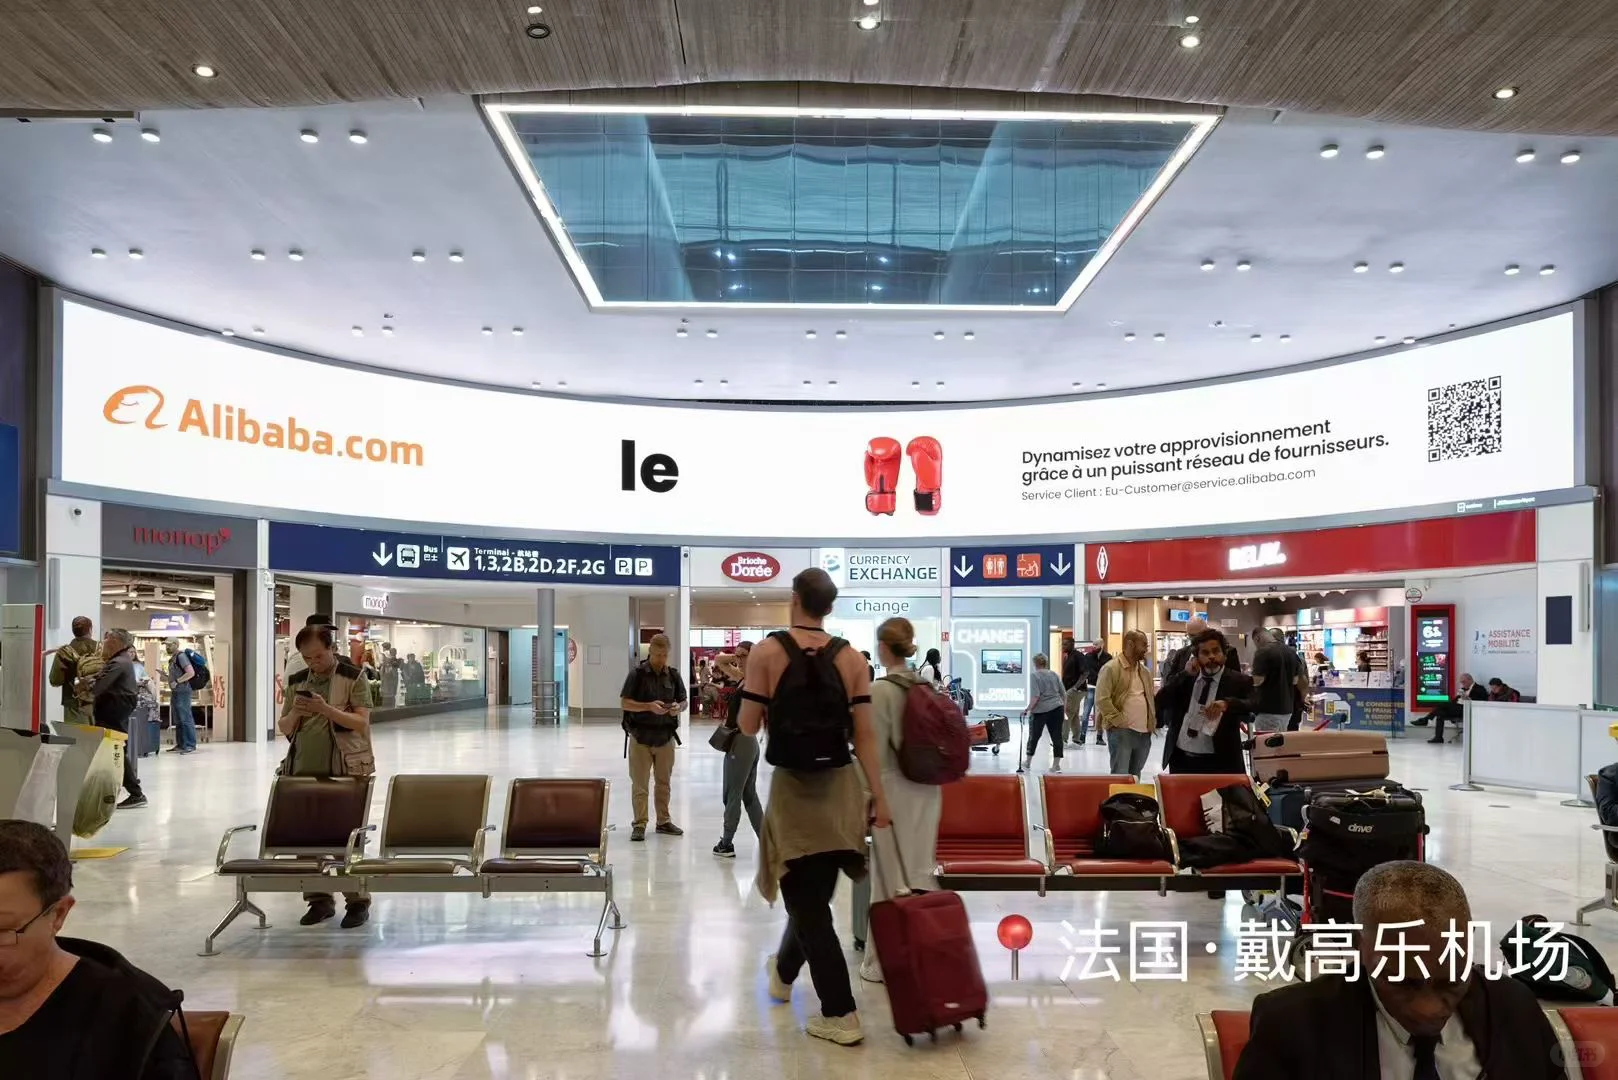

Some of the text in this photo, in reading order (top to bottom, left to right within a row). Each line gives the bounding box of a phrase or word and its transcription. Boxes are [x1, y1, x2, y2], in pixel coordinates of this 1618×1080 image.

[178, 398, 424, 467] Alibaba.com
[1022, 419, 1332, 468] Dynamisez votre approvisionnement
[621, 439, 679, 493] le
[1022, 433, 1390, 487] grâce à un puissant réseau de fournisseurs.
[1021, 490, 1062, 501] Service
[1064, 487, 1098, 499] Client
[1105, 468, 1317, 497] Eu-Customer@service.alibaba.com
[423, 544, 438, 554] Bus
[474, 546, 510, 557] Terminal
[423, 553, 438, 562] 巴士
[474, 555, 606, 576] 1,3,2B,2D,2F,2G
[737, 556, 768, 566] Brioche
[849, 555, 911, 565] CURRENCY
[731, 561, 773, 578] Dorée
[849, 567, 938, 580] EXCHANGE
[855, 599, 910, 615] change
[957, 628, 1025, 644] CHANGE
[1488, 628, 1531, 639] ASSISTANCE
